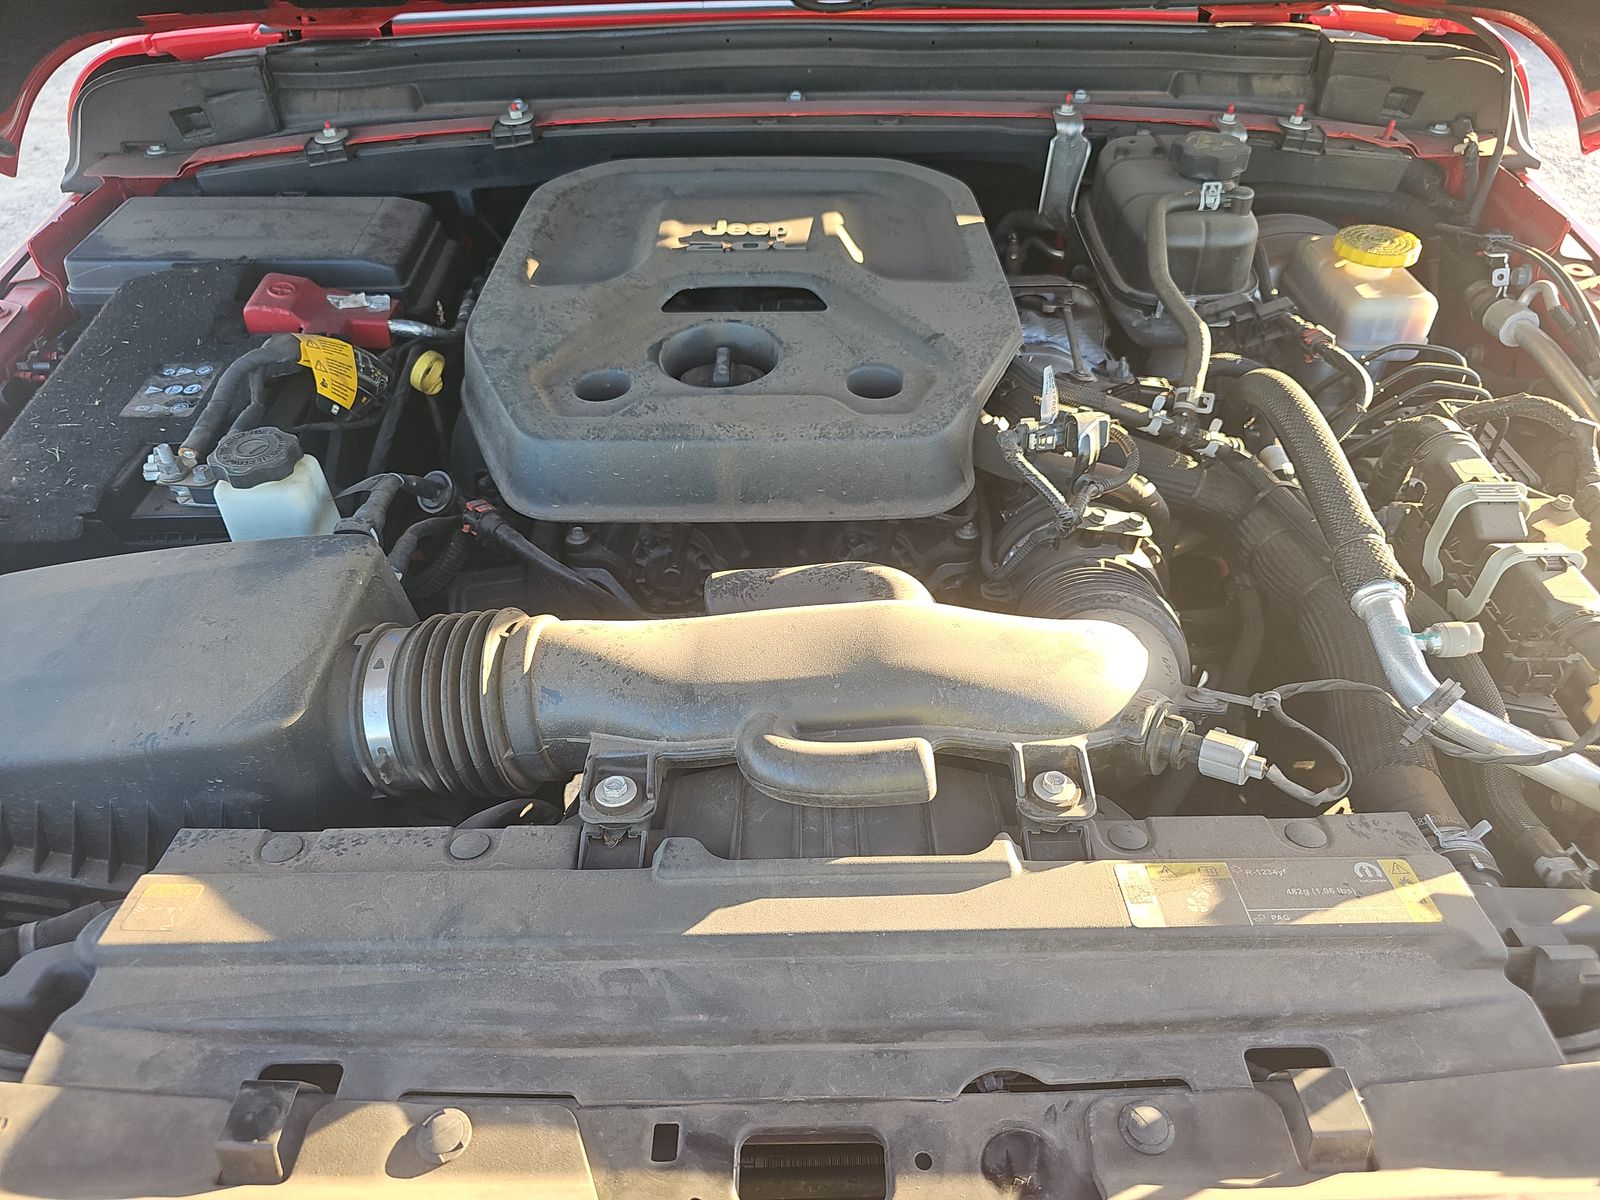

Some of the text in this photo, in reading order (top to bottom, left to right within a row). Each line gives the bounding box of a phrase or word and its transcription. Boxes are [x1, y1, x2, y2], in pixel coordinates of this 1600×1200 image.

[701, 218, 793, 242] Jeep
[1286, 887, 1357, 896] 482g (1.06 lbs)
